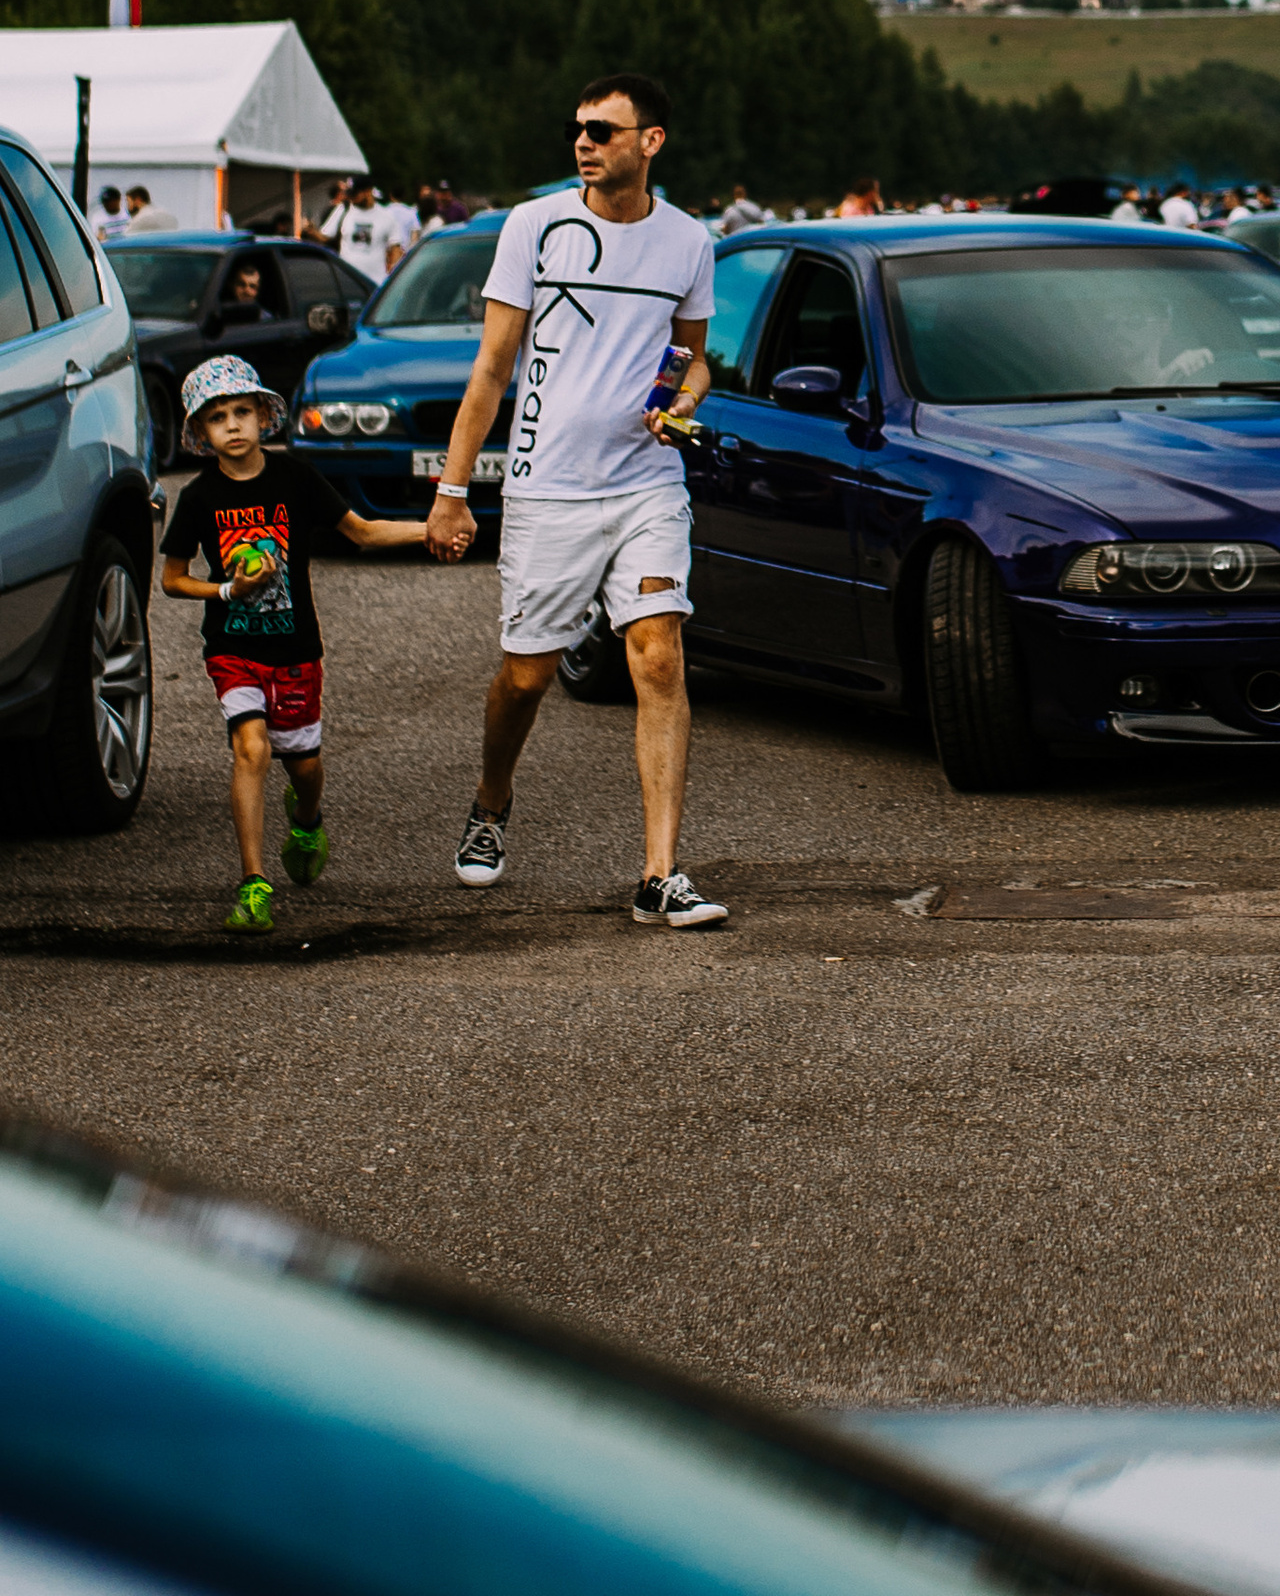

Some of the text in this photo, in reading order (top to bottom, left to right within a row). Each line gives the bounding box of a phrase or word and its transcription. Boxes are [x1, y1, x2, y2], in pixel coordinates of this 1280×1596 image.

[511, 331, 561, 479] Jeans
[215, 504, 289, 529] LIKE A
